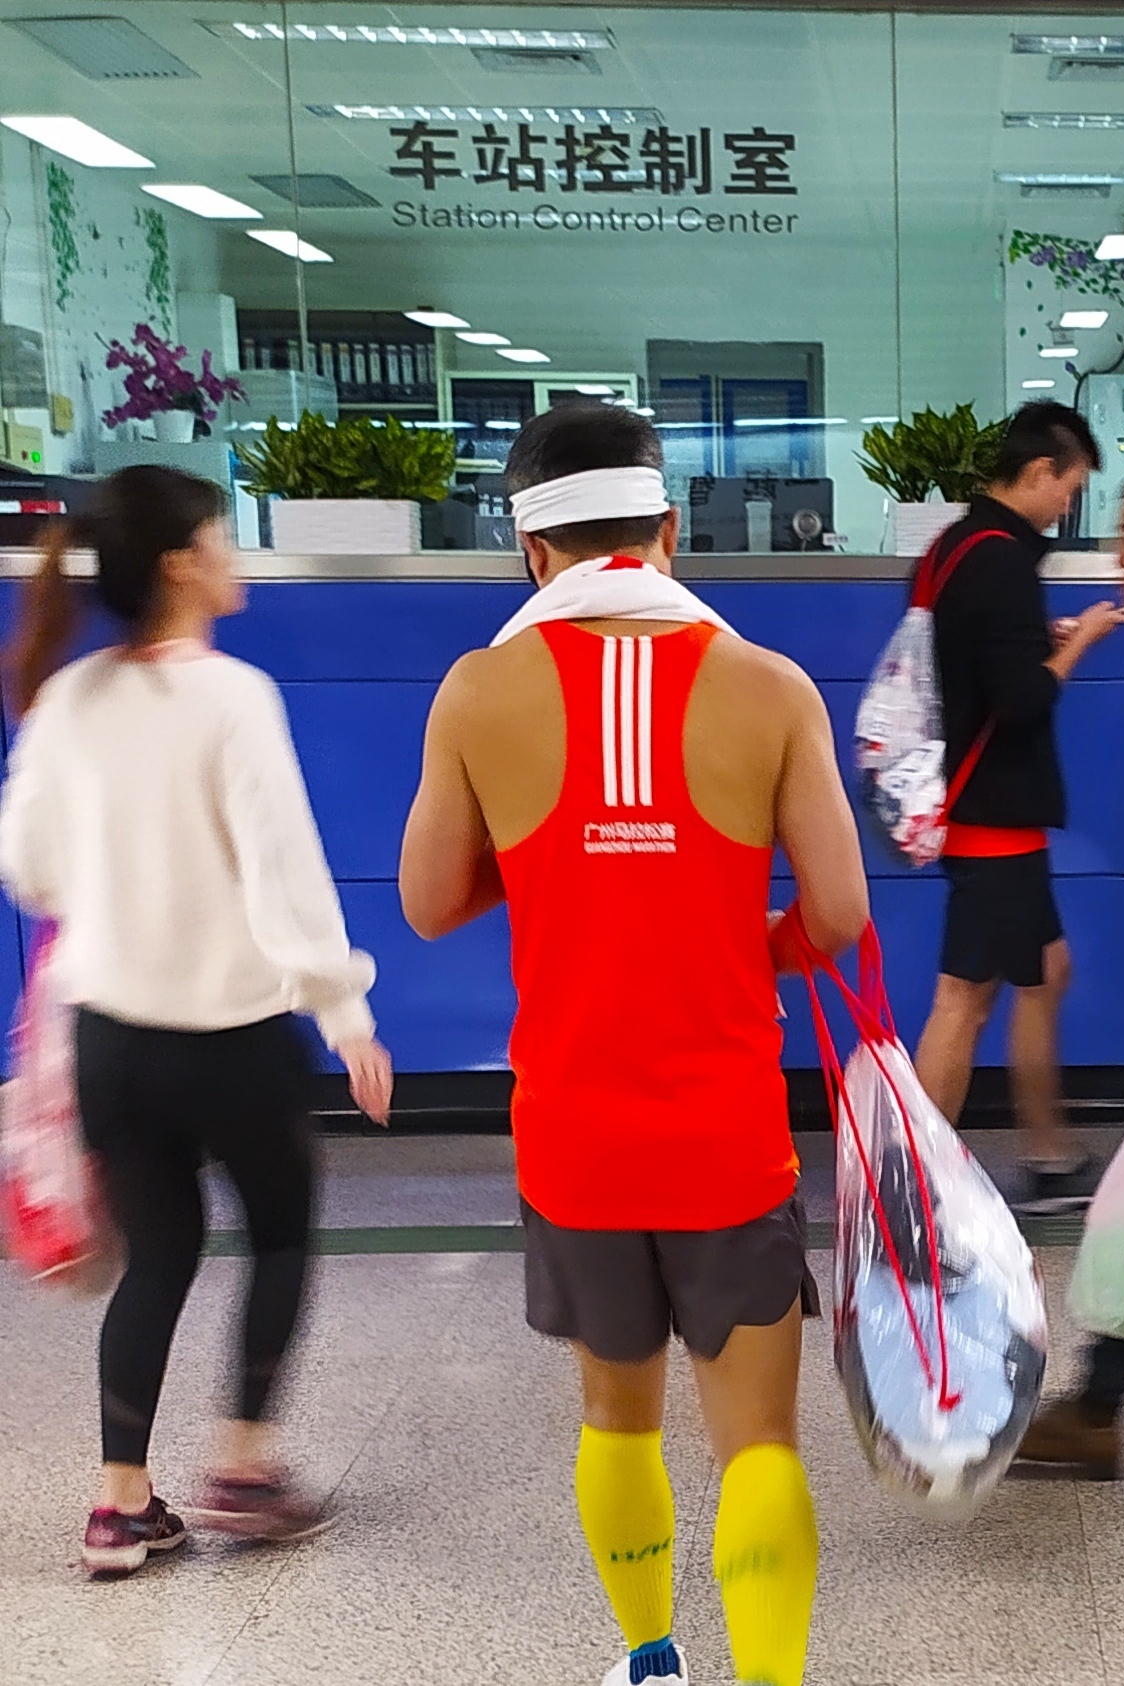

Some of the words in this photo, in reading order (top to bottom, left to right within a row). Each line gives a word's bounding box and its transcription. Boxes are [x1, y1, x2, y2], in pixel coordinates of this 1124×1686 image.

[389, 121, 798, 195] 车站控制室
[392, 201, 519, 230] Station
[533, 204, 665, 232] Control
[677, 206, 799, 234] Center
